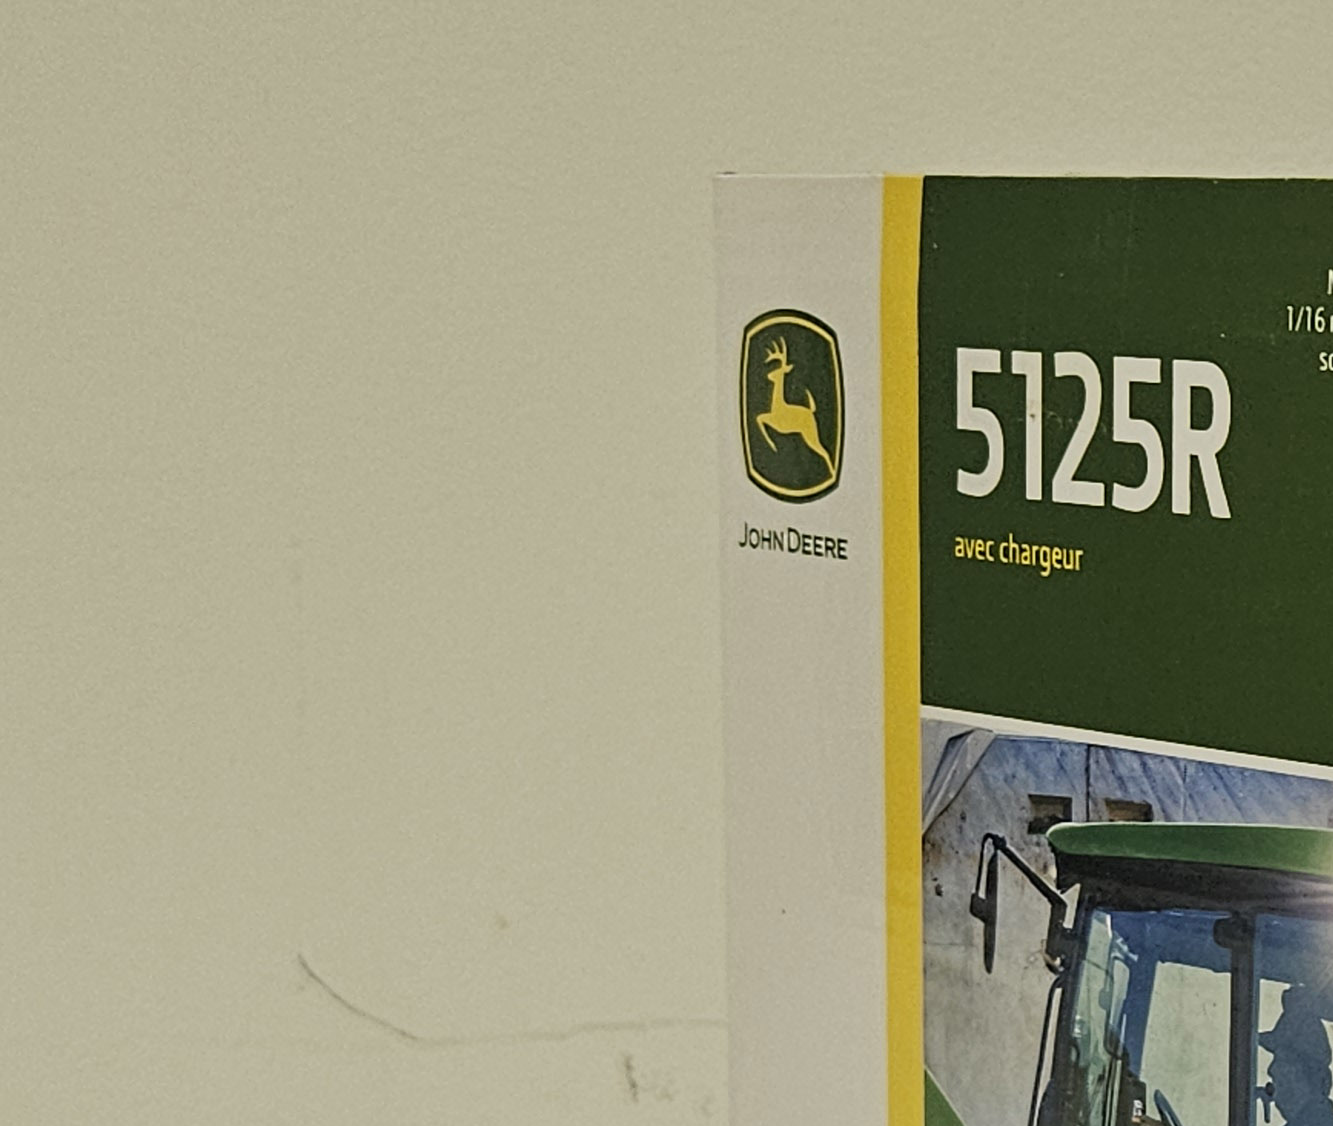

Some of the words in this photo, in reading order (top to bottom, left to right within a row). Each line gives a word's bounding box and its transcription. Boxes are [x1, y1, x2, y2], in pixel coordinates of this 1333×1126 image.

[1286, 305, 1326, 333] 1/16
[955, 346, 1232, 520] 5125R
[738, 522, 785, 552] JOHN
[787, 527, 849, 560] DEERE
[954, 535, 996, 562] avec
[999, 533, 1084, 577] chargeur
